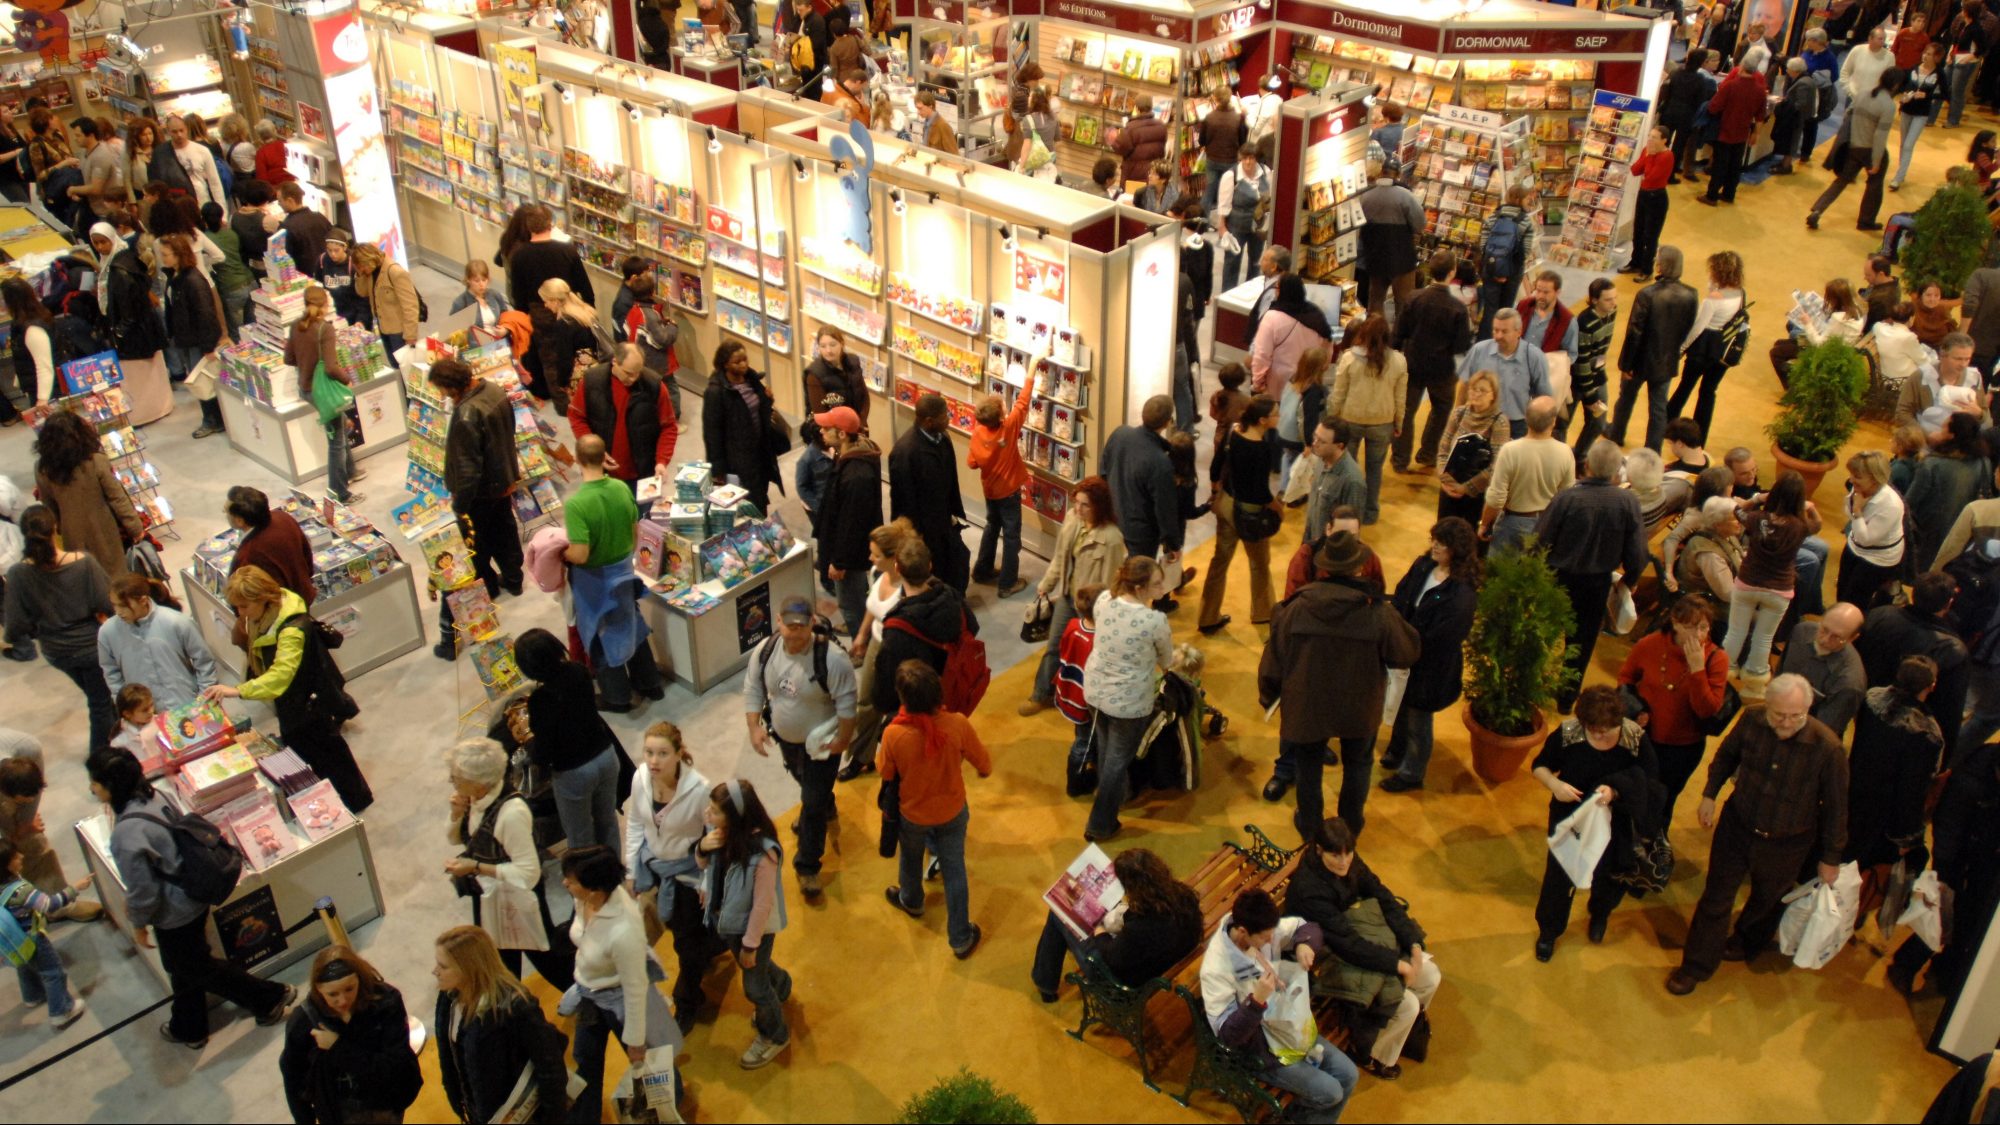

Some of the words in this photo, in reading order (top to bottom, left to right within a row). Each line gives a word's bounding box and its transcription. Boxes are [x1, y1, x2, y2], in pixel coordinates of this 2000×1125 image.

[1219, 6, 1255, 33] SAEP
[1332, 11, 1403, 39] Dormonval
[1455, 36, 1532, 48] DORMONVAL
[1575, 36, 1608, 48] SAEP
[1450, 109, 1489, 123] SAEP
